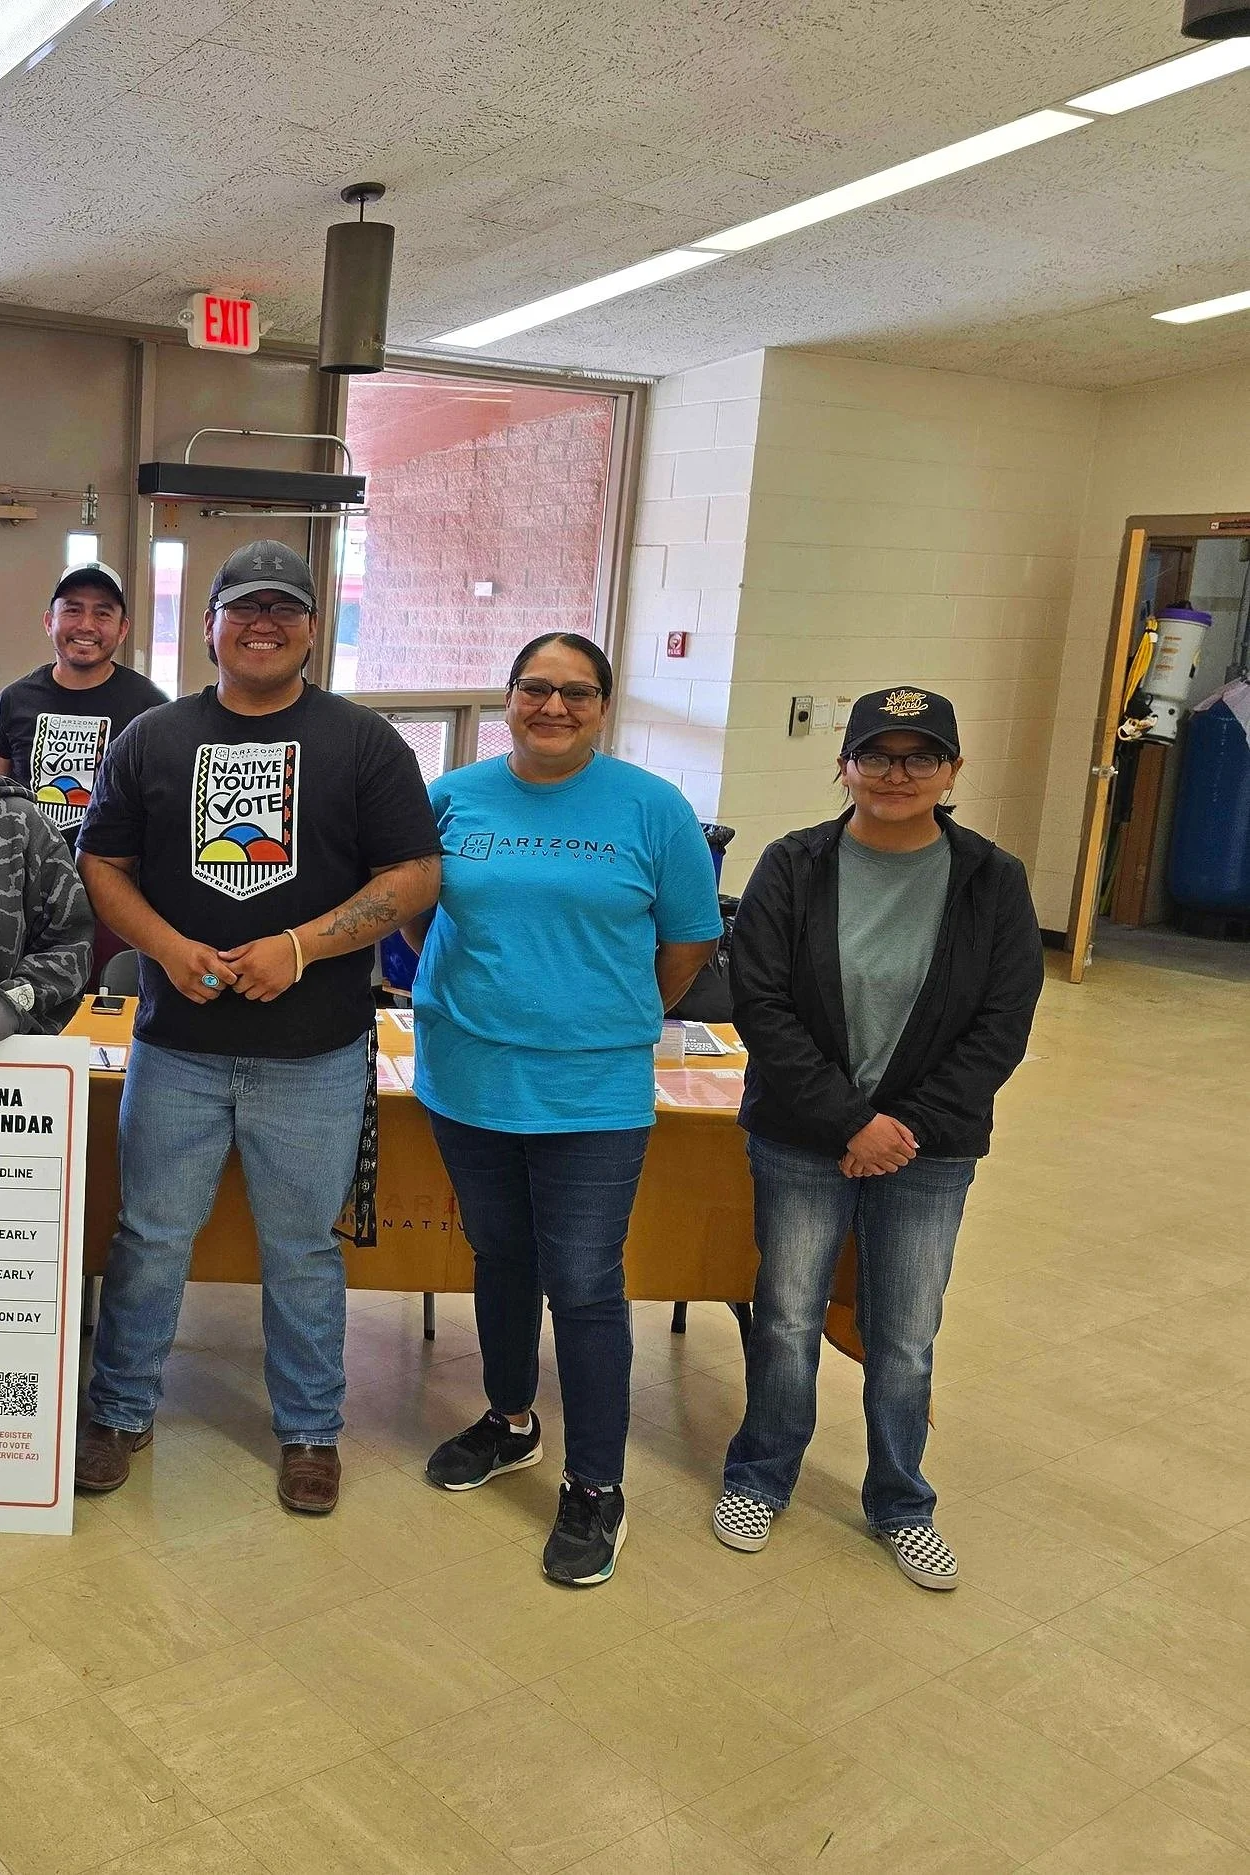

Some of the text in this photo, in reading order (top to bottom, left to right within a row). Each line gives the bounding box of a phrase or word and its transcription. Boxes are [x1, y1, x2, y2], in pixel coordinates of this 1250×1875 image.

[205, 296, 251, 347] EXIT
[47, 730, 97, 742] NATIVE
[47, 741, 95, 755] YOUTH
[231, 747, 283, 756] ARIZONA
[211, 760, 282, 775] NATIVE
[211, 774, 281, 791] YOUTH
[498, 837, 616, 854] ARIZONA
[573, 853, 616, 864] VOTE
[194, 869, 214, 884] DON'T
[214, 880, 223, 888] BE
[223, 885, 236, 894] ALL
[273, 870, 294, 883] VOTE!
[16, 1312, 41, 1323] DAY
[11, 1441, 30, 1450] VOTE
[24, 1452, 39, 1461] AZ)
